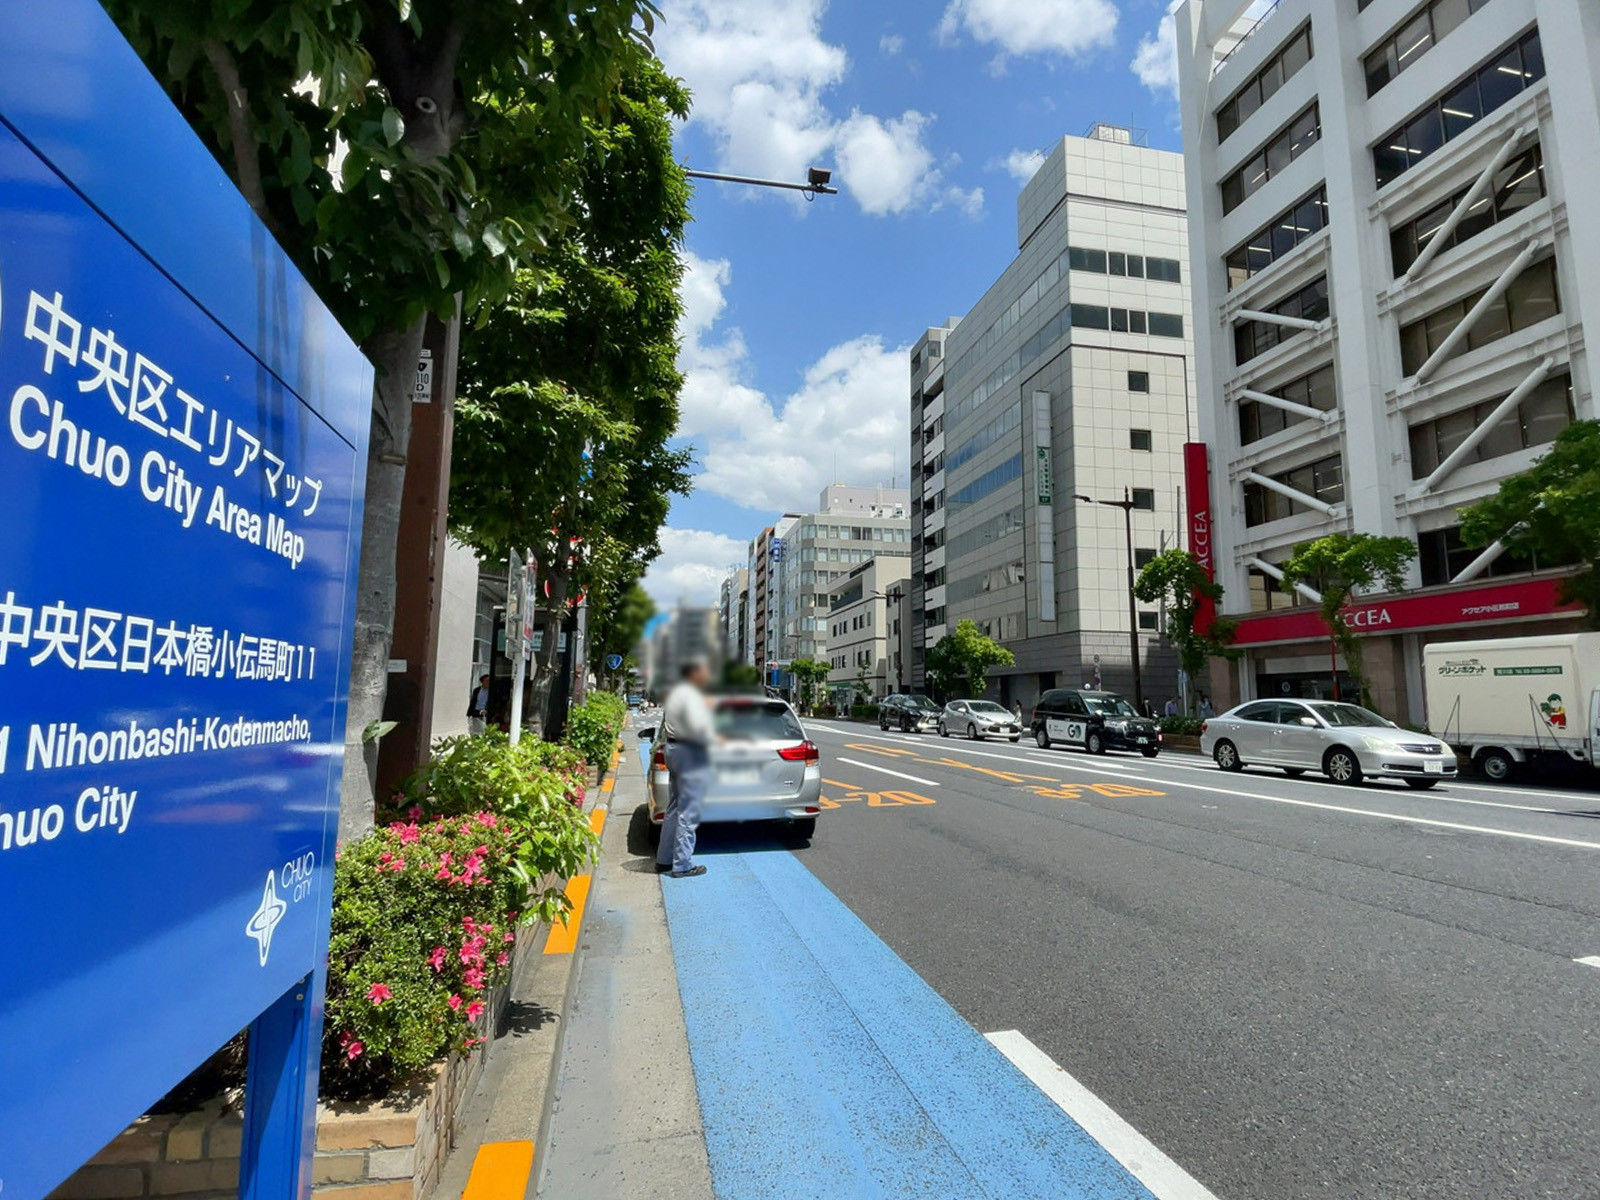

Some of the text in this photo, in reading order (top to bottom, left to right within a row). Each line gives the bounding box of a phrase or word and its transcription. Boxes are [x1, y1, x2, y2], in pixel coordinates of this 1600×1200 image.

[24, 289, 323, 517] 中央区エリアマップ
[9, 384, 305, 570] Chuo City Area Map
[1194, 510, 1209, 570] ACCEA
[0, 591, 316, 682] 中央区日本橋小伝馬町11
[1336, 608, 1392, 628] CCEA
[25, 714, 312, 771] Nihonbashi-Kodenmacho,
[1067, 723, 1082, 739] GO
[75, 785, 138, 834] City
[281, 851, 315, 889] CHUO
[293, 877, 313, 903] CITY
